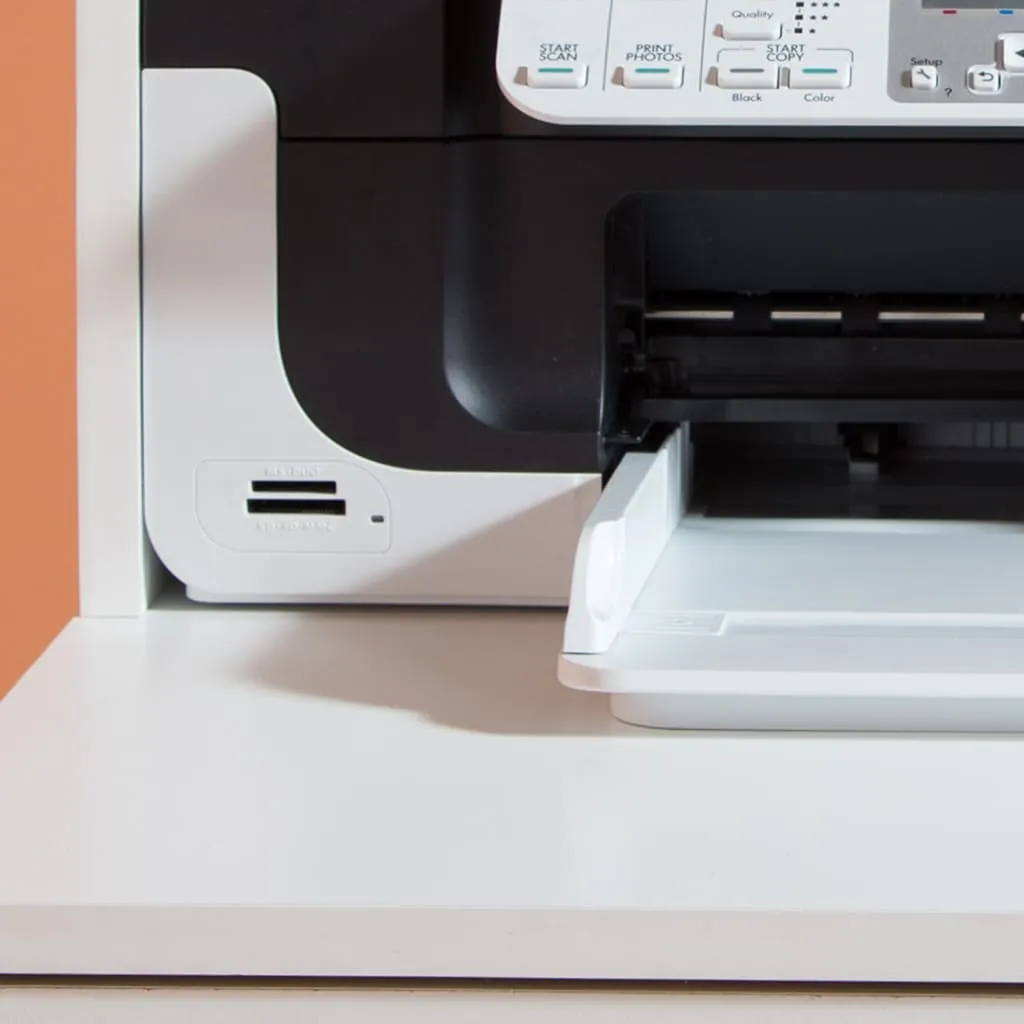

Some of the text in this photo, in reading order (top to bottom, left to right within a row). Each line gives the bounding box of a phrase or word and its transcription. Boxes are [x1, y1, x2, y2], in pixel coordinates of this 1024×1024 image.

[731, 10, 774, 20] Quality
[539, 43, 579, 53] START
[635, 43, 674, 53] PRINT
[766, 44, 806, 54] START
[539, 52, 578, 62] SCAN
[625, 52, 682, 62] PHOTOS
[766, 52, 804, 62] COPY
[910, 57, 943, 69] Setup
[732, 92, 763, 103] Black
[803, 92, 836, 103] Color
